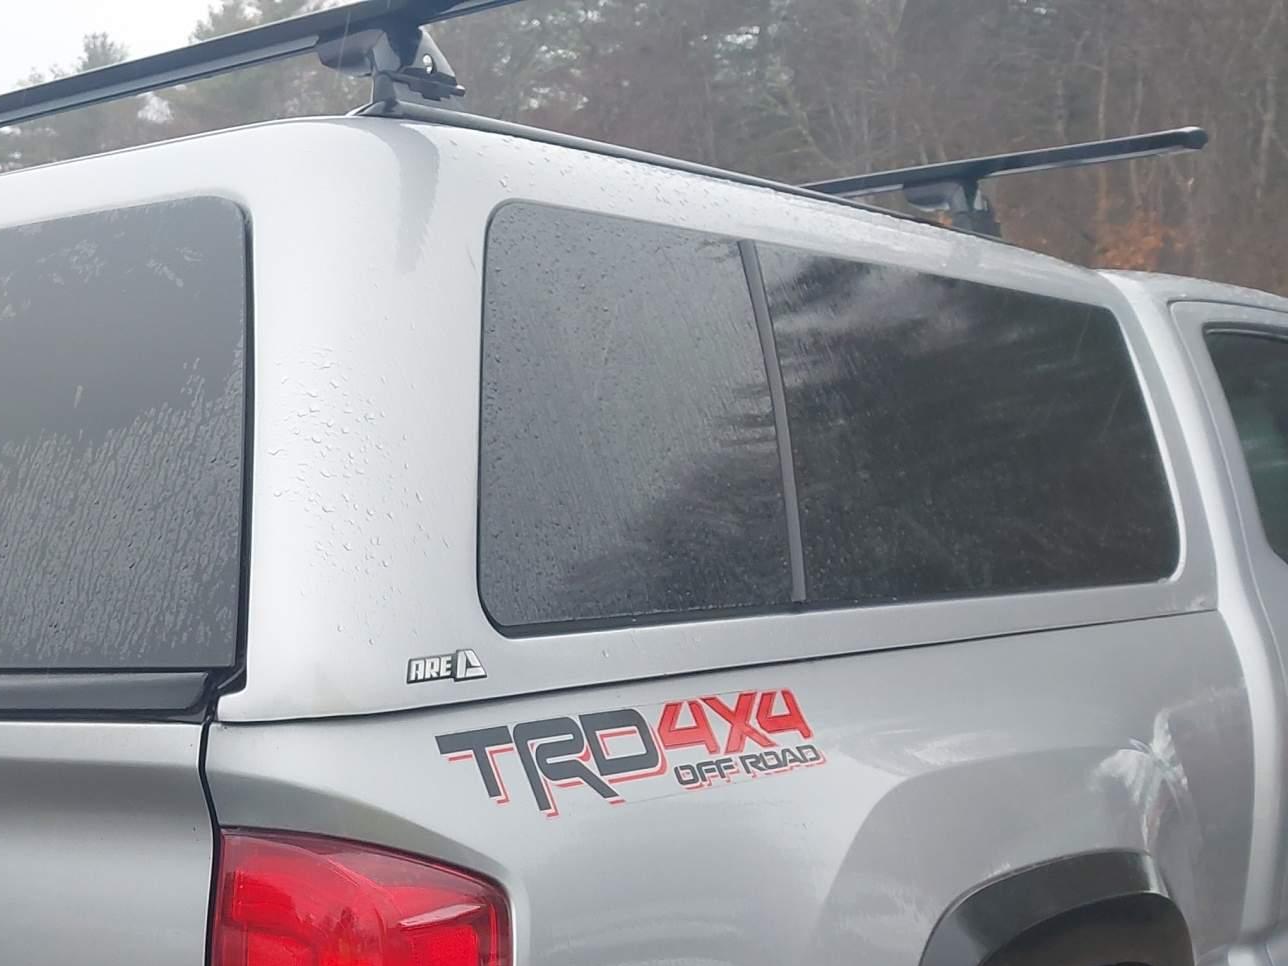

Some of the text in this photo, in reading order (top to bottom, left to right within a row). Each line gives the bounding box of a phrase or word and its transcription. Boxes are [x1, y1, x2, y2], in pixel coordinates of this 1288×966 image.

[409, 654, 452, 682] ARE
[434, 707, 667, 818] TRD
[672, 743, 826, 791] OFF ROAD
